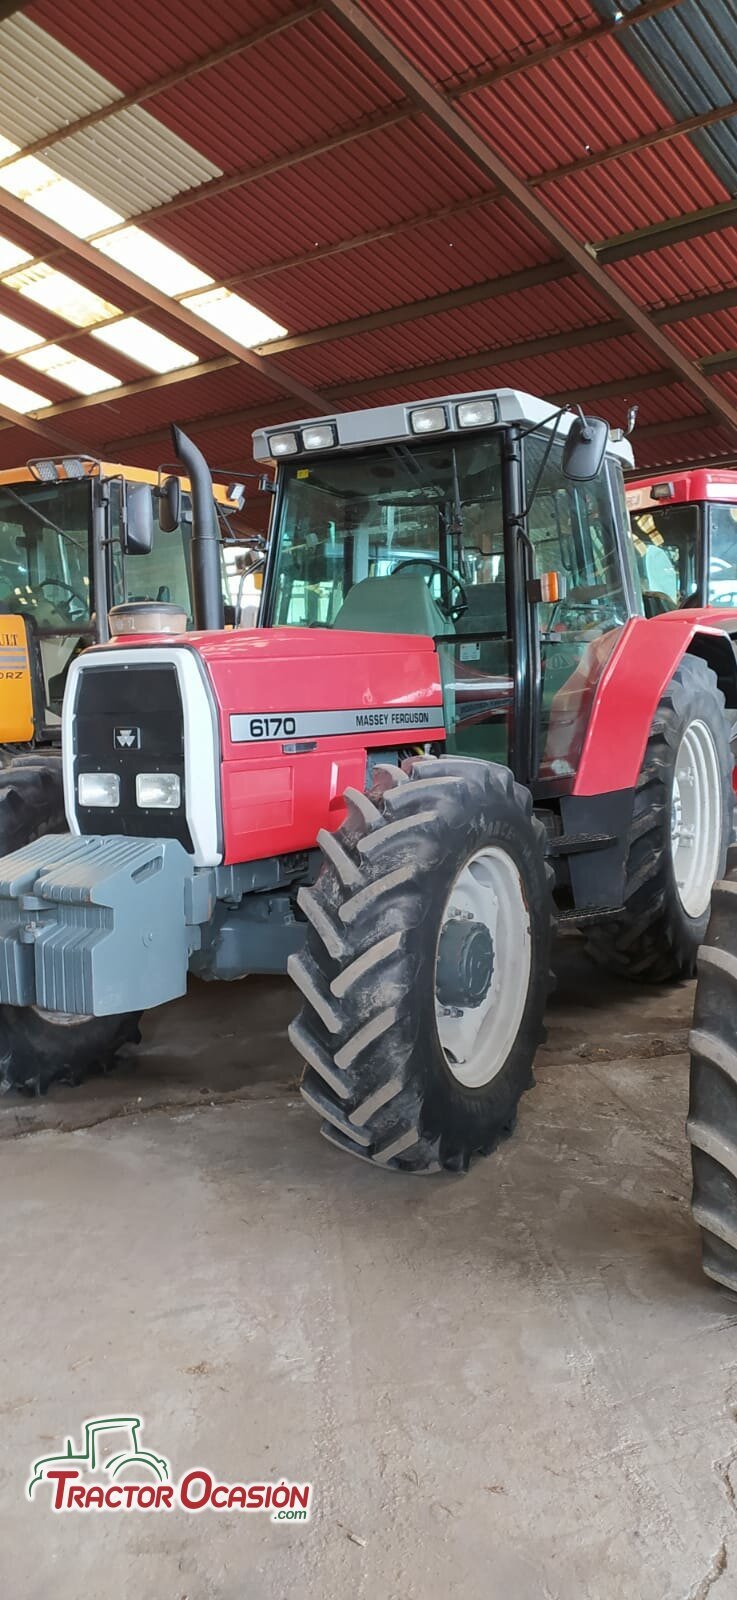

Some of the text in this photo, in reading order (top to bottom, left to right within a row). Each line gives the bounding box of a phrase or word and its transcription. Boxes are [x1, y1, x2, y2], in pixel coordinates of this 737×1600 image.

[250, 712, 429, 738] 6170 MASSEY FERGUSON
